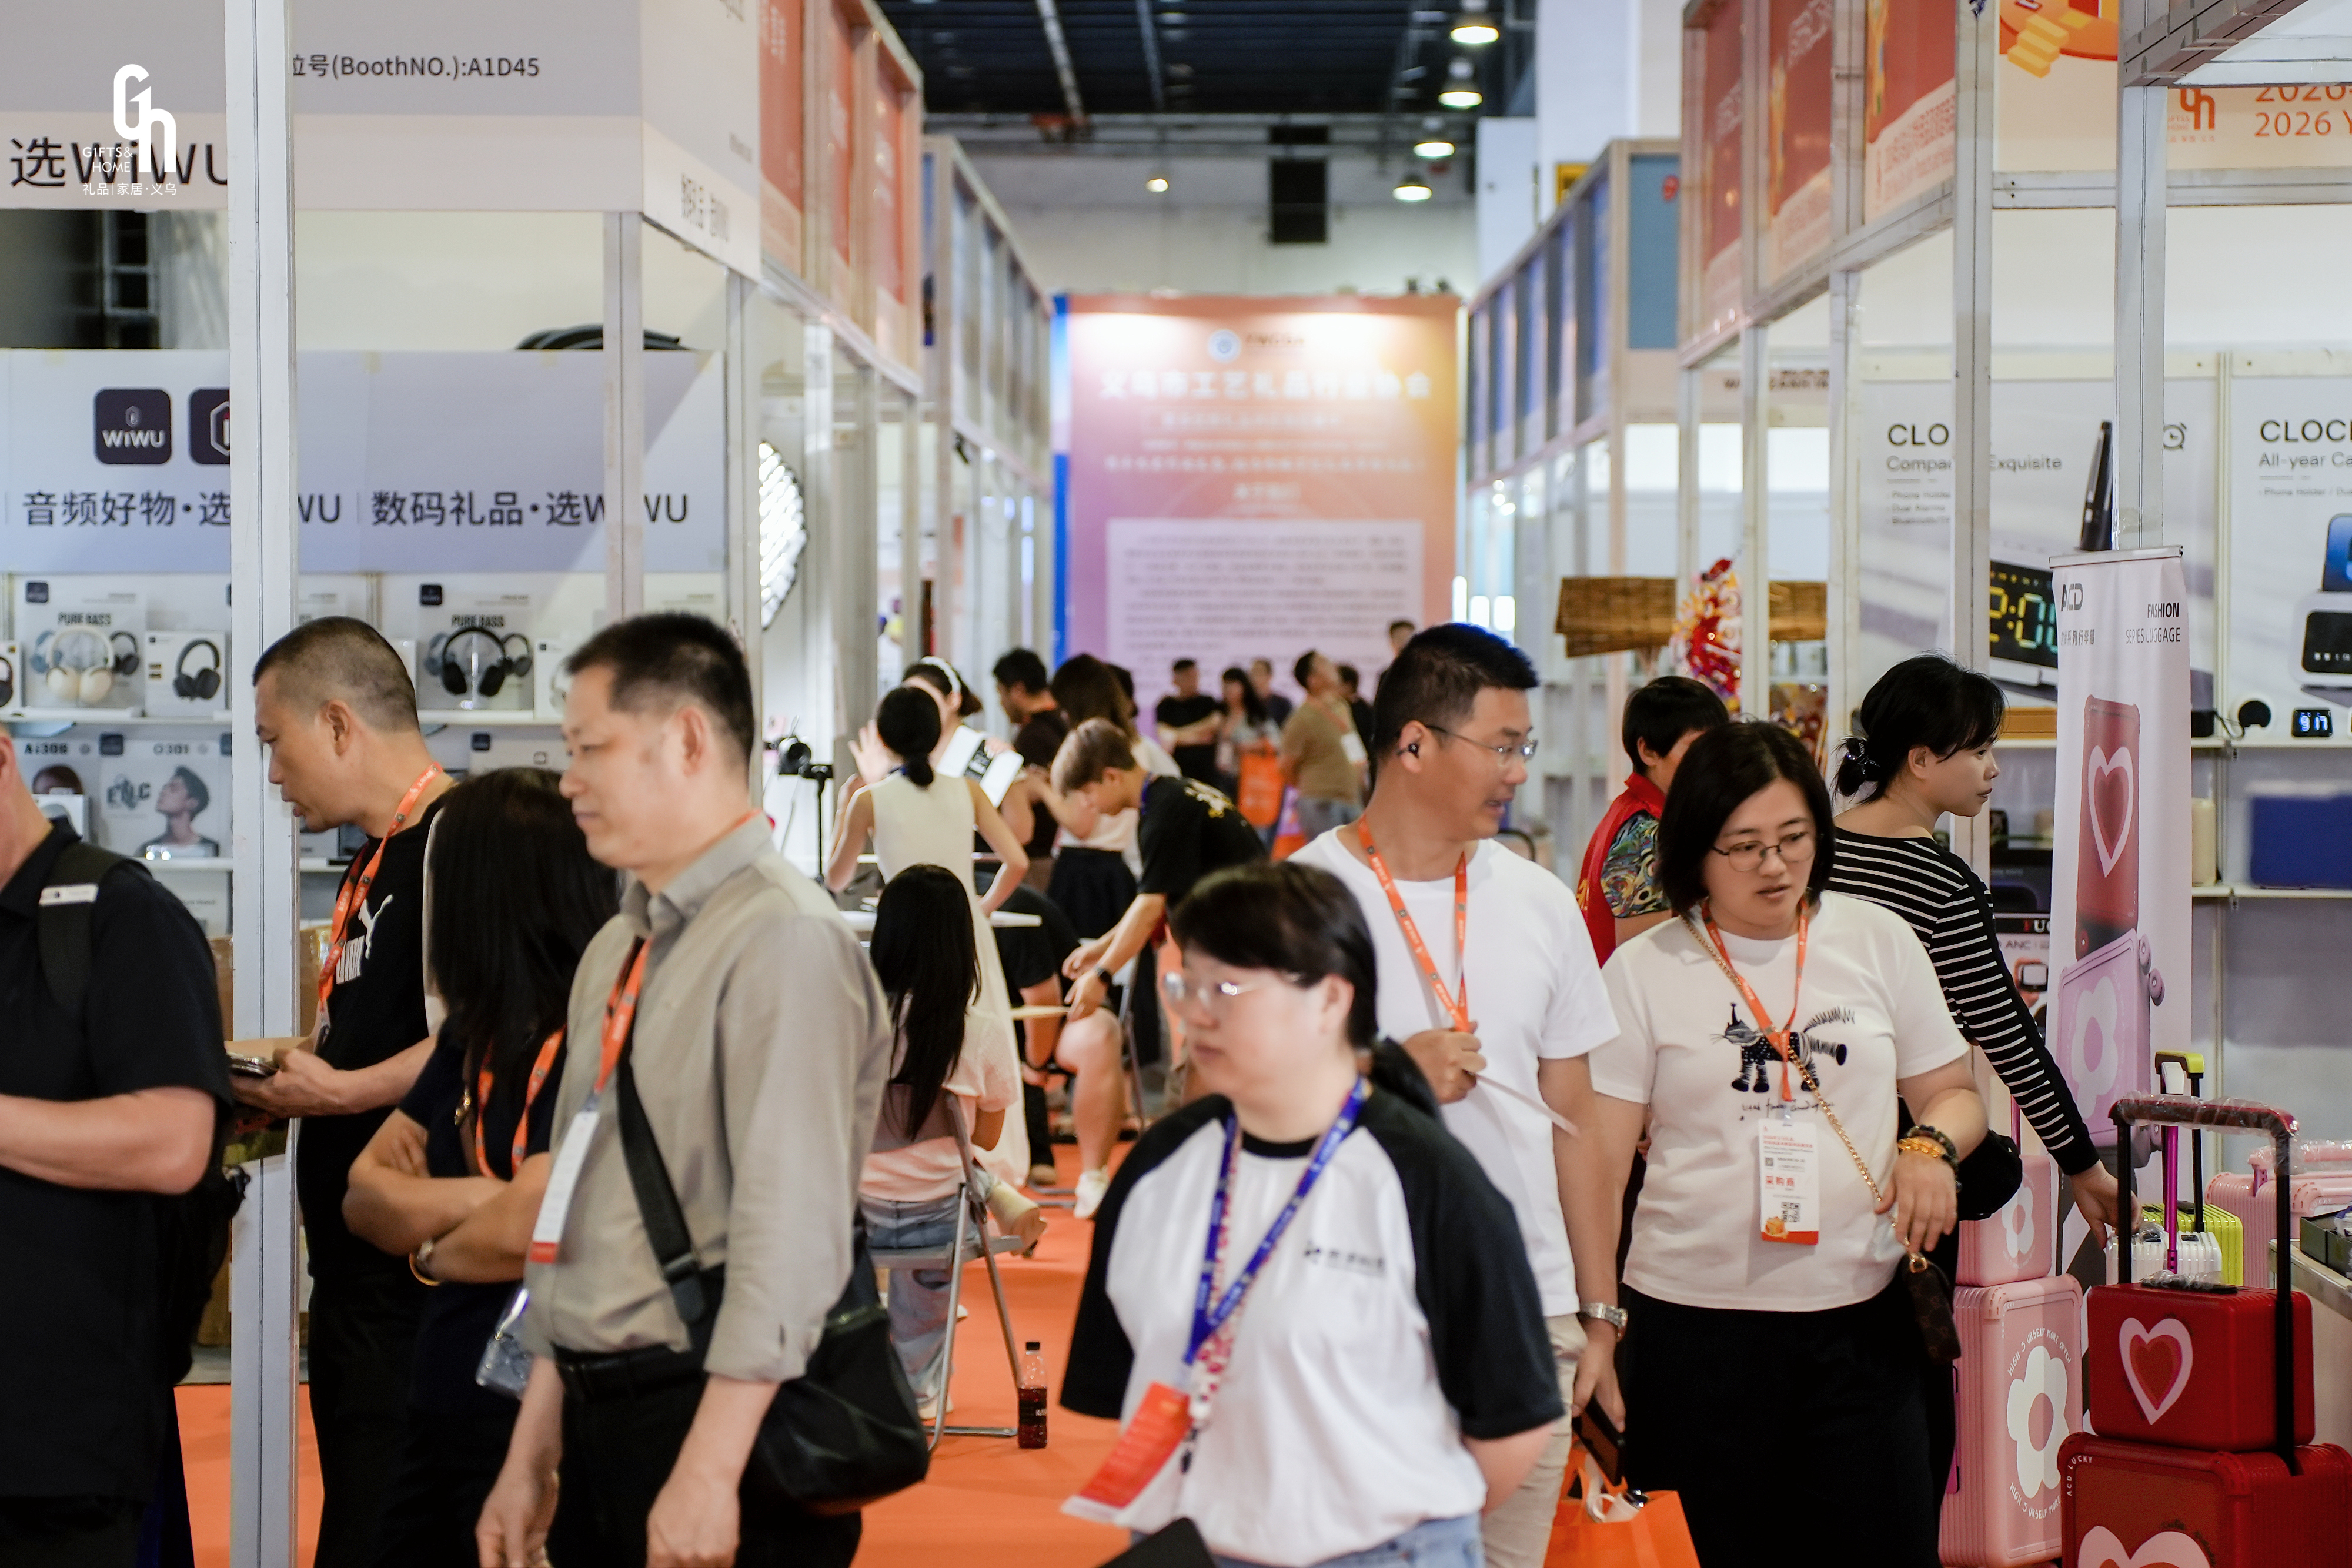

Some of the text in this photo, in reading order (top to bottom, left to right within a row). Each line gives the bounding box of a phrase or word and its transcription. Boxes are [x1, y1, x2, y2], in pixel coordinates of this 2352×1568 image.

[2254, 110, 2332, 137] 2026
[1887, 423, 1950, 447] CLO
[2260, 419, 2352, 442] CLOC
[1886, 455, 1952, 473] Compa
[2259, 452, 2326, 470] All-year
[2060, 583, 2083, 612] ACD
[2147, 603, 2179, 618] FASHION
[2126, 627, 2181, 644] SERIES LUGGAGE
[2007, 1351, 2021, 1377] HIGH
[2026, 1327, 2046, 1345] URSELF
[2046, 1329, 2059, 1345] MORE
[2067, 1455, 2093, 1470] LUCKY
[2009, 1482, 2022, 1507] HIGH
[2028, 1507, 2048, 1520] URSELF
